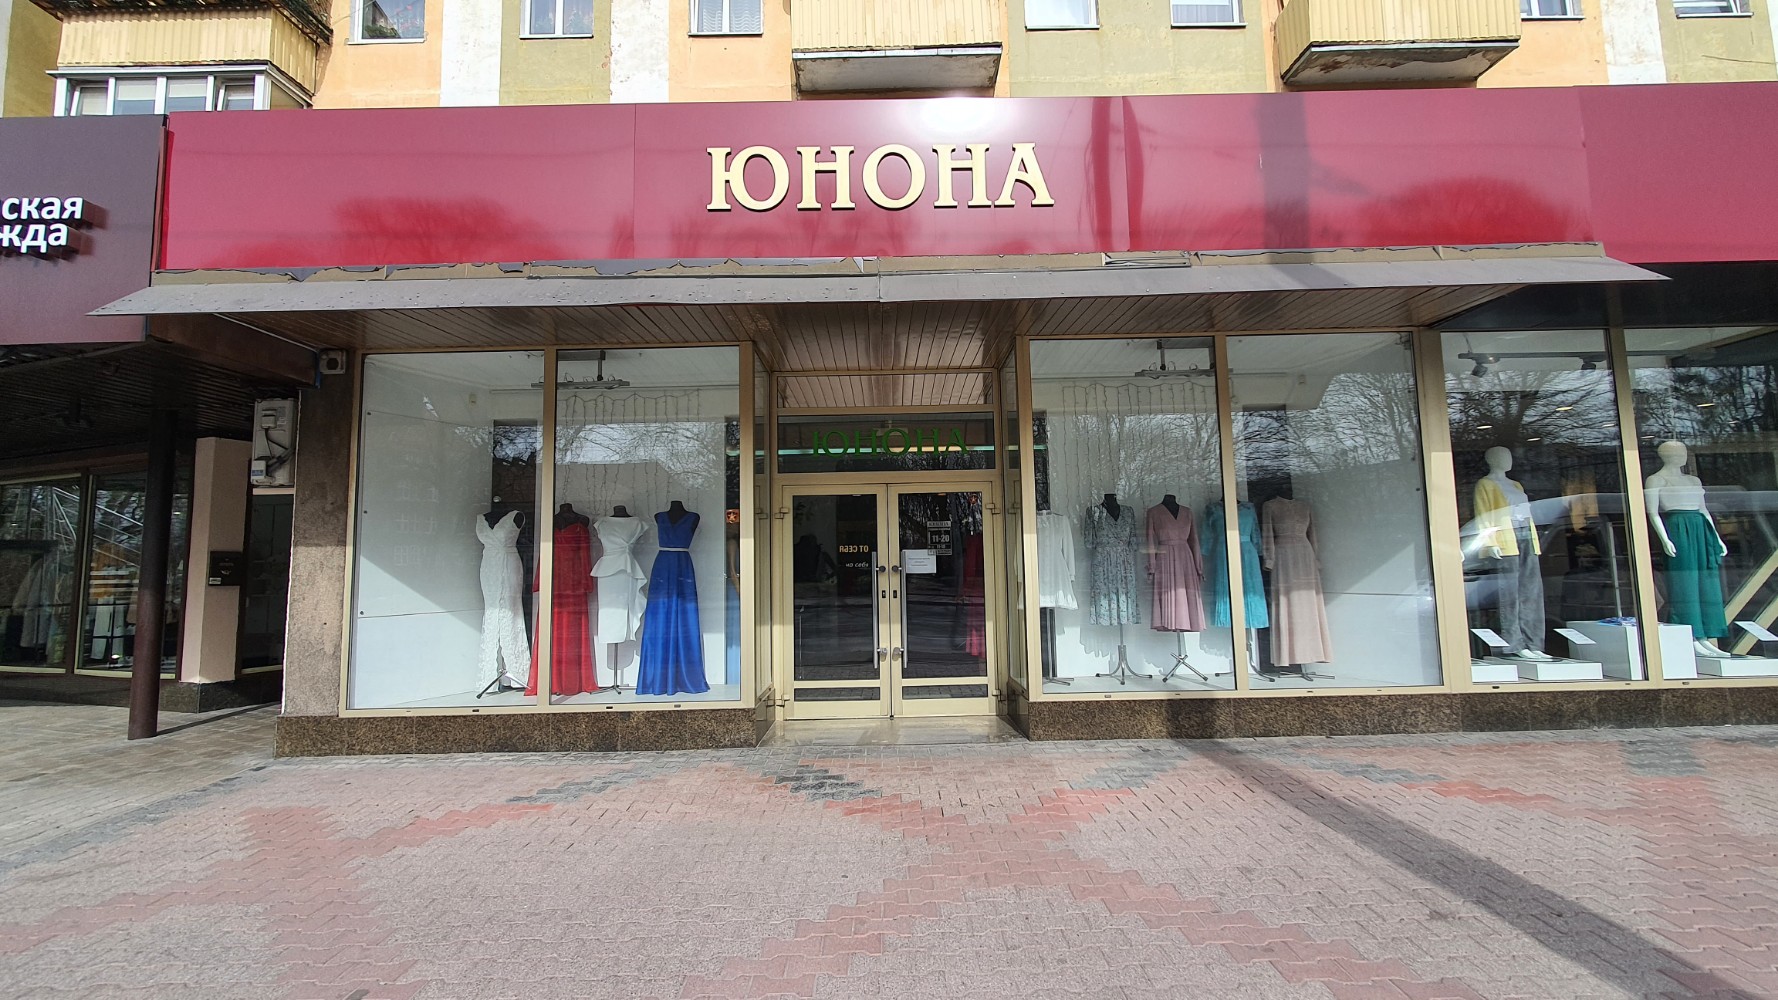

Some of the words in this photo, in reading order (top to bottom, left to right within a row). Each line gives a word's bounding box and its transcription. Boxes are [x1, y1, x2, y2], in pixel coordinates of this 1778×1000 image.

[706, 144, 1055, 212] ЮНОНА
[2, 196, 83, 220] ская
[812, 427, 969, 459] ЮНОНА
[931, 534, 950, 543] 11-20
